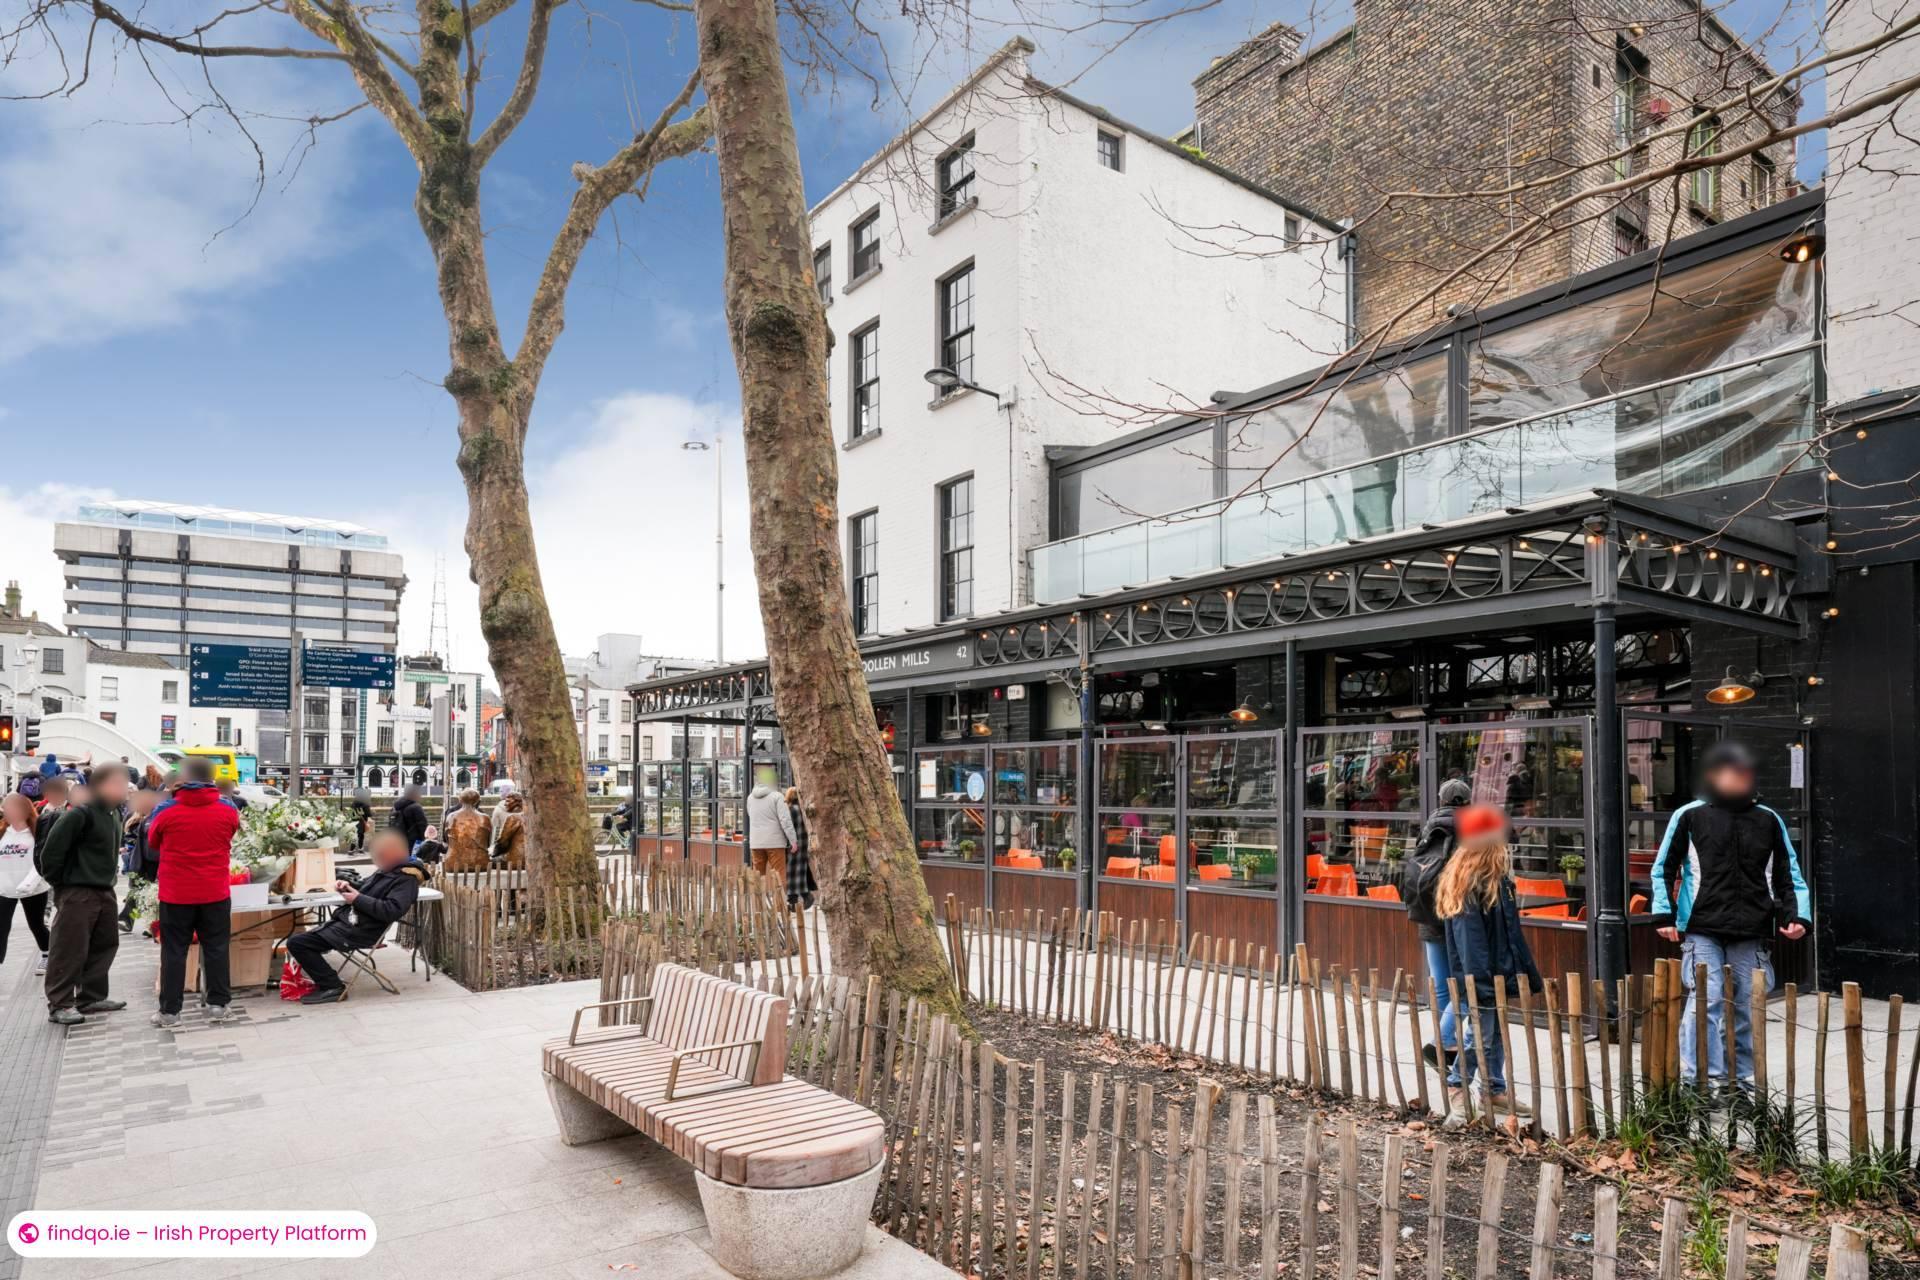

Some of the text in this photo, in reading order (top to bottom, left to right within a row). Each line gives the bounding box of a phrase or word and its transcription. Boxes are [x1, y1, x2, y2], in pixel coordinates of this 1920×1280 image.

[956, 645, 967, 659] 42
[862, 651, 930, 673] OOLLEN MILLS
